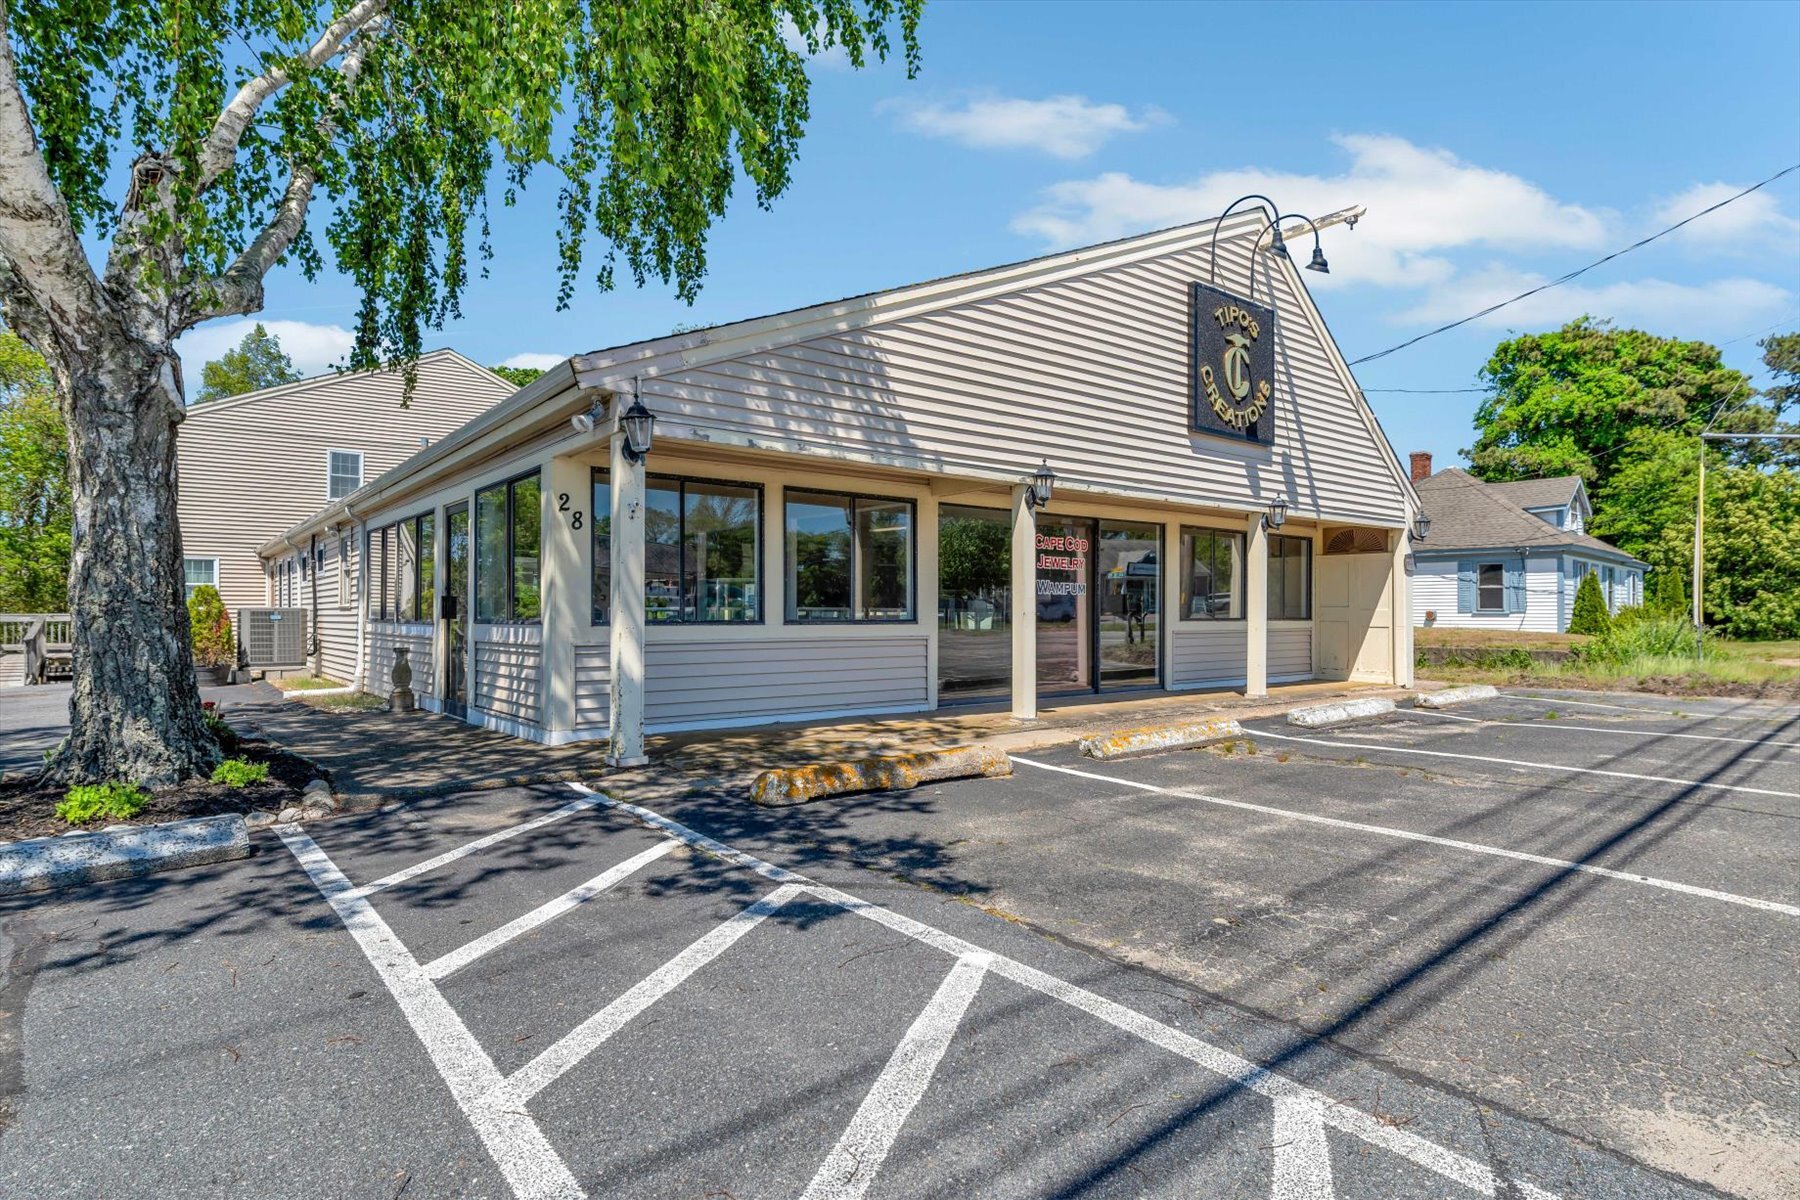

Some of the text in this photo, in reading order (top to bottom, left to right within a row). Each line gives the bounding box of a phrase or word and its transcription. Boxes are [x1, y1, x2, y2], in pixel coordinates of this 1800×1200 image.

[1214, 306, 1260, 340] TIPO'S
[1200, 365, 1271, 428] CREATIONS
[559, 493, 582, 530] 28
[1035, 534, 1088, 552] CAPE COD
[1037, 554, 1085, 571] JEWELRY
[1036, 579, 1086, 596] WAMPUM
